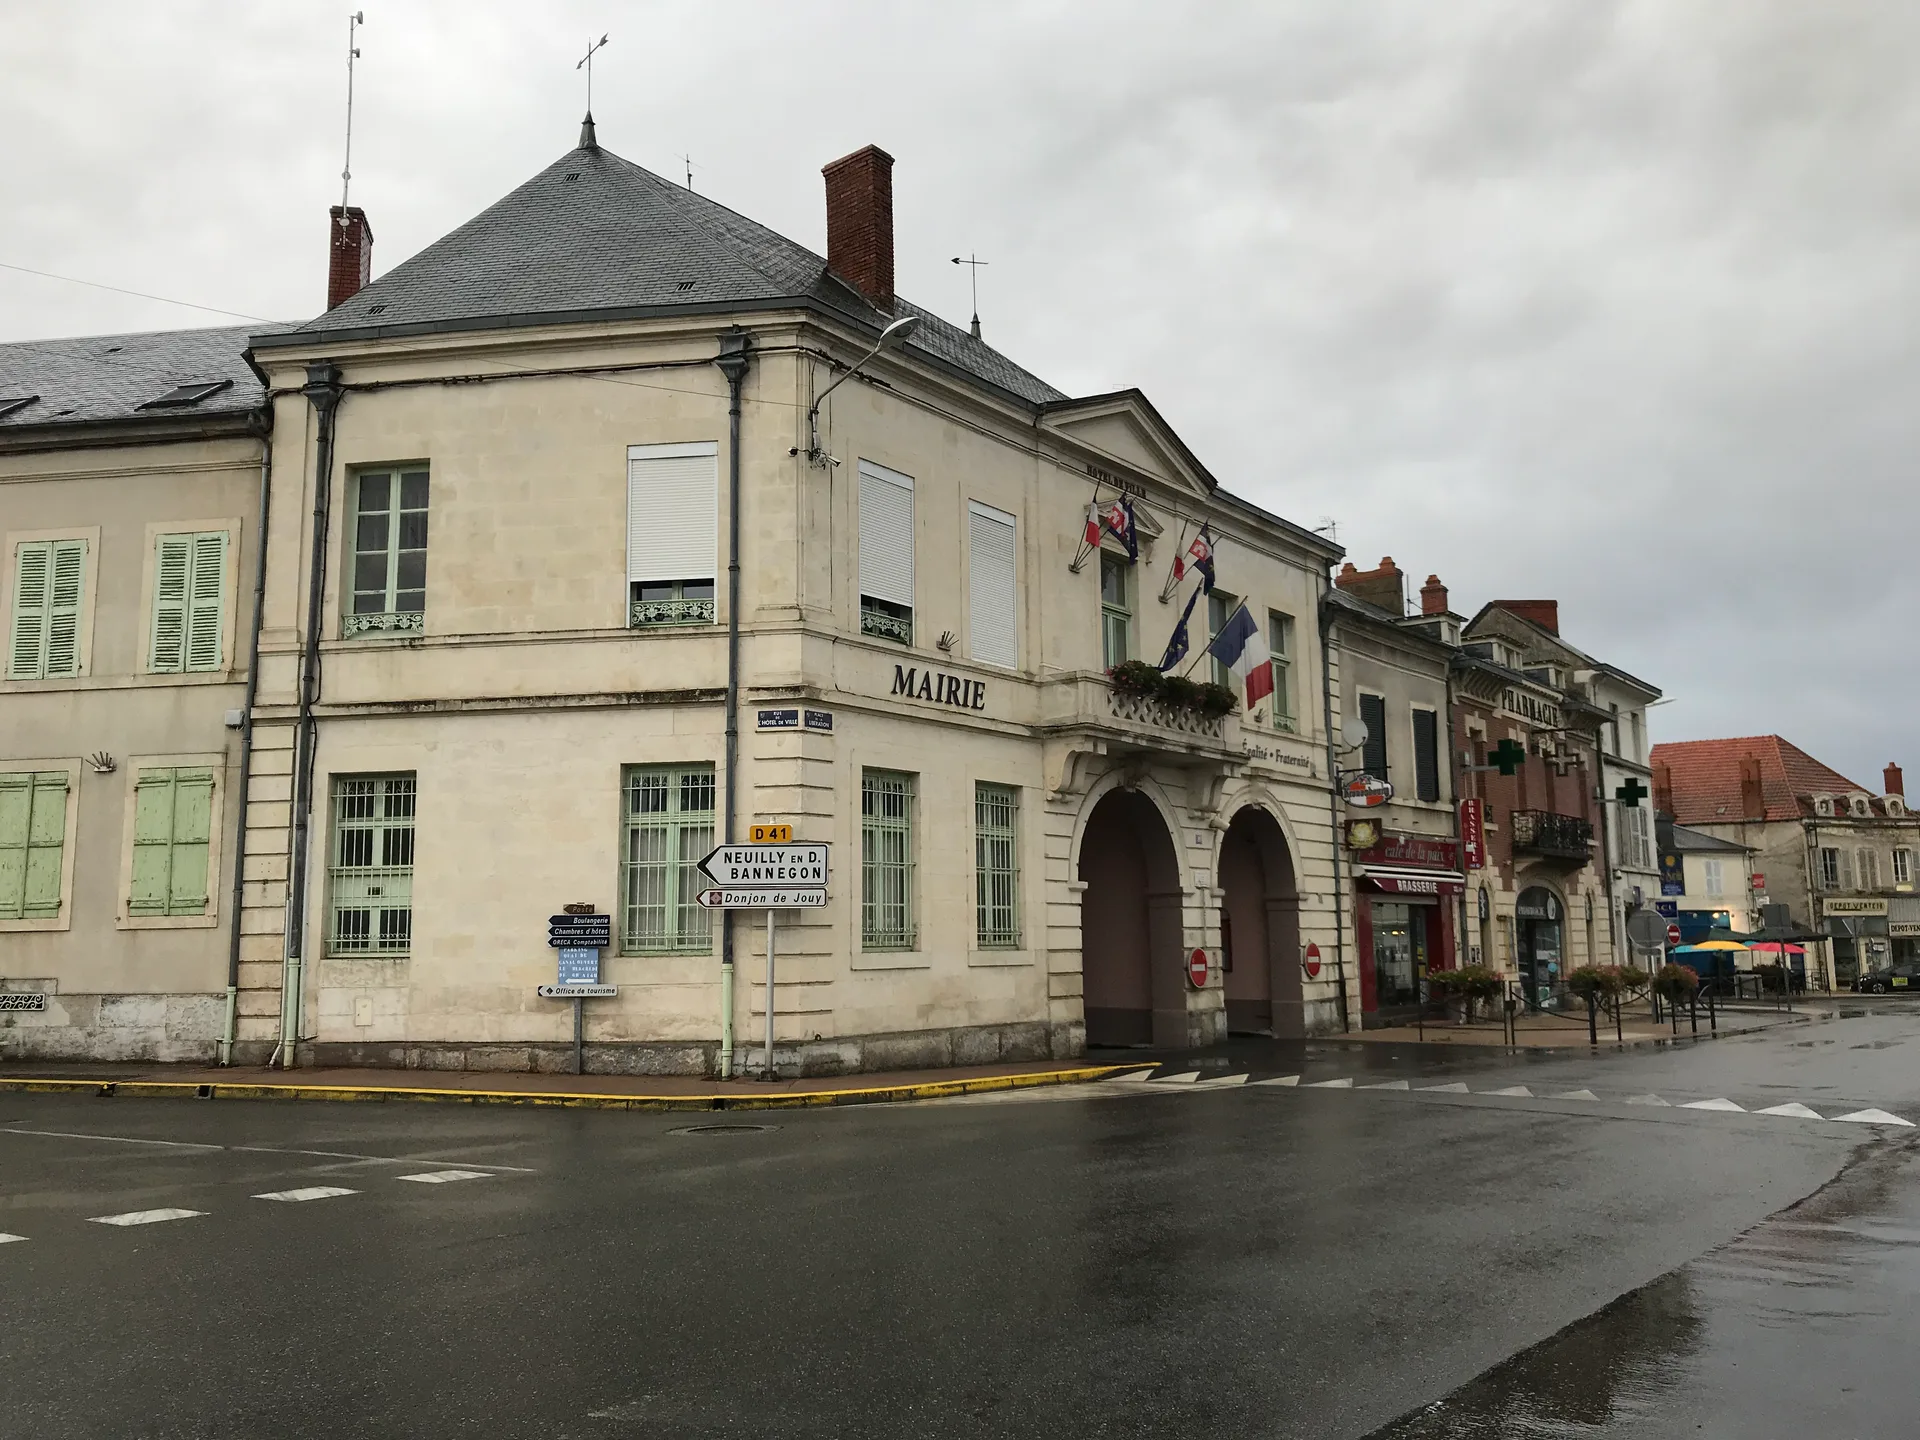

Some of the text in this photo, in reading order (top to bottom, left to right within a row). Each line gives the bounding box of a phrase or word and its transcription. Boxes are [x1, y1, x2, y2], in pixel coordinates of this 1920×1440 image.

[890, 664, 985, 710] MAIRIE
[1501, 688, 1559, 728] PHARMACIE
[1242, 738, 1310, 768] Égalité Fraternité
[755, 827, 787, 840] D 41
[724, 851, 821, 864] NEUILLY EN D.
[730, 867, 821, 880] BANNEGON
[1396, 879, 1438, 893] BRASSERIE
[725, 893, 822, 906] Donjon de Jouy
[573, 917, 609, 926] Boulangerie
[585, 927, 609, 935] d'hôtes
[555, 987, 616, 995] Office de tourisme
